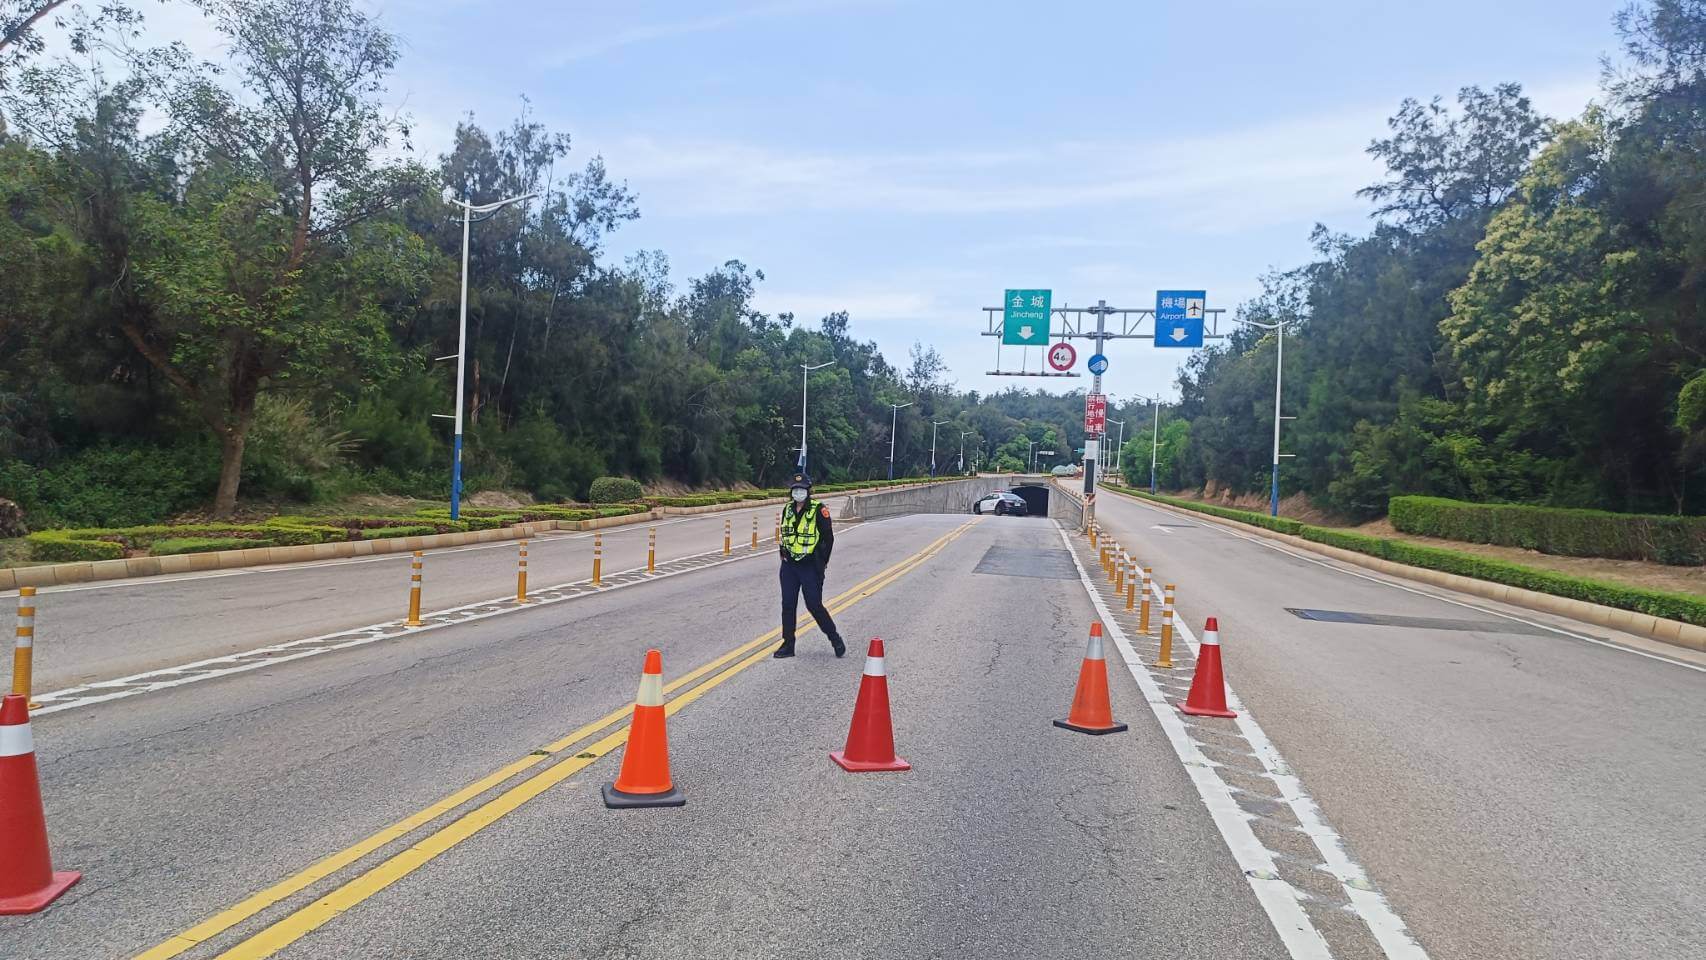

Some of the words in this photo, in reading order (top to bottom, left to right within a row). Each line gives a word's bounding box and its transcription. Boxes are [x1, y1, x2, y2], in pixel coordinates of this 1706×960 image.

[1011, 295, 1045, 308] 金城
[1161, 297, 1186, 309] 機場
[1010, 311, 1044, 320] Jincheng
[1160, 312, 1185, 321] Airport
